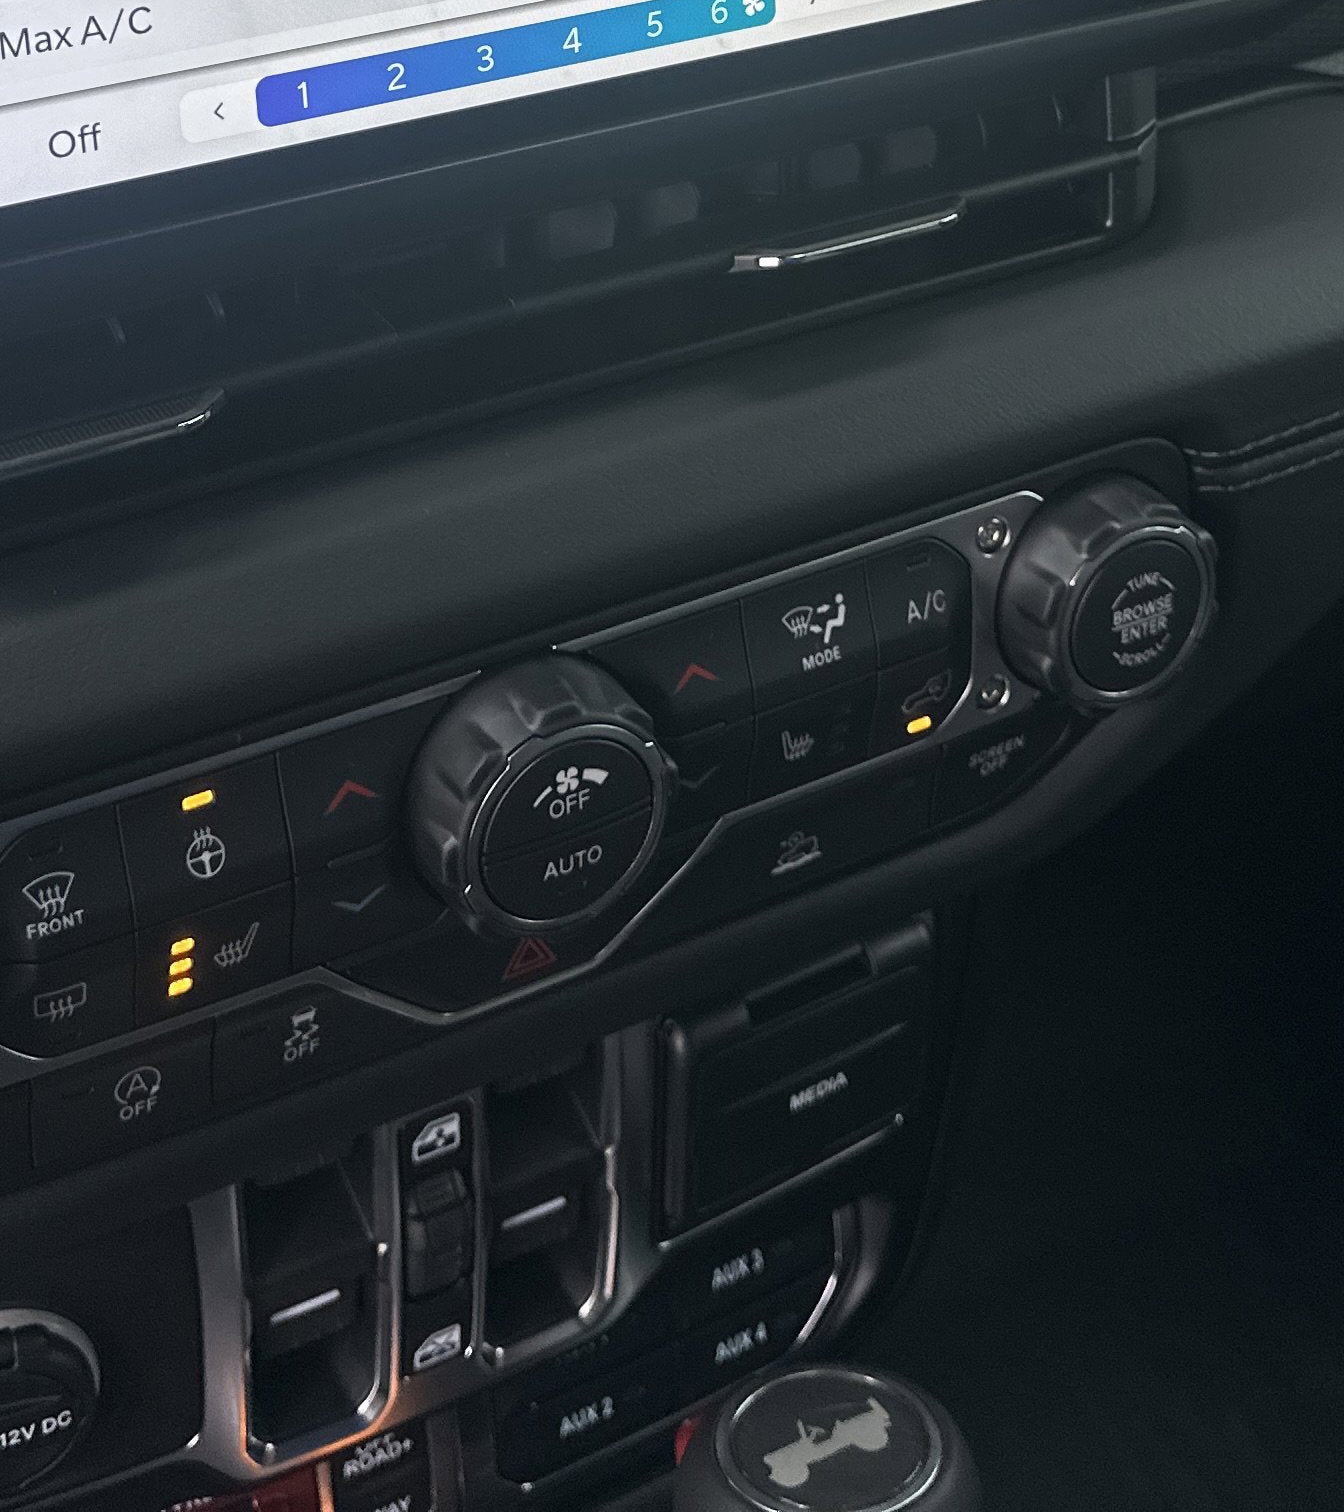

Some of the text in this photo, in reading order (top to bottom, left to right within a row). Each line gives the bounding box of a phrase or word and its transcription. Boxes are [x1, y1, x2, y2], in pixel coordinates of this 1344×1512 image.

[80, 6, 154, 47] A/C
[296, 81, 310, 110] 1
[386, 63, 408, 91] 2
[476, 45, 496, 73] 3
[562, 26, 583, 55] 4
[646, 10, 664, 38] 5
[48, 121, 104, 159] Off
[1127, 571, 1160, 591] TUNE
[907, 589, 947, 624] A/C
[1113, 592, 1173, 626] BROWSE
[1121, 615, 1168, 644] ENTER
[802, 645, 842, 671] MODE
[548, 788, 591, 821] OFF
[543, 843, 604, 882] AUTO
[25, 908, 86, 940] FRONT
[283, 1037, 322, 1063] OFF
[118, 1096, 158, 1121] OFF
[789, 1071, 849, 1114] MEDIA
[712, 1254, 751, 1292] AUX
[715, 1327, 753, 1366] AUX
[40, 1408, 74, 1434] DC
[560, 1396, 615, 1439] AUX 2
